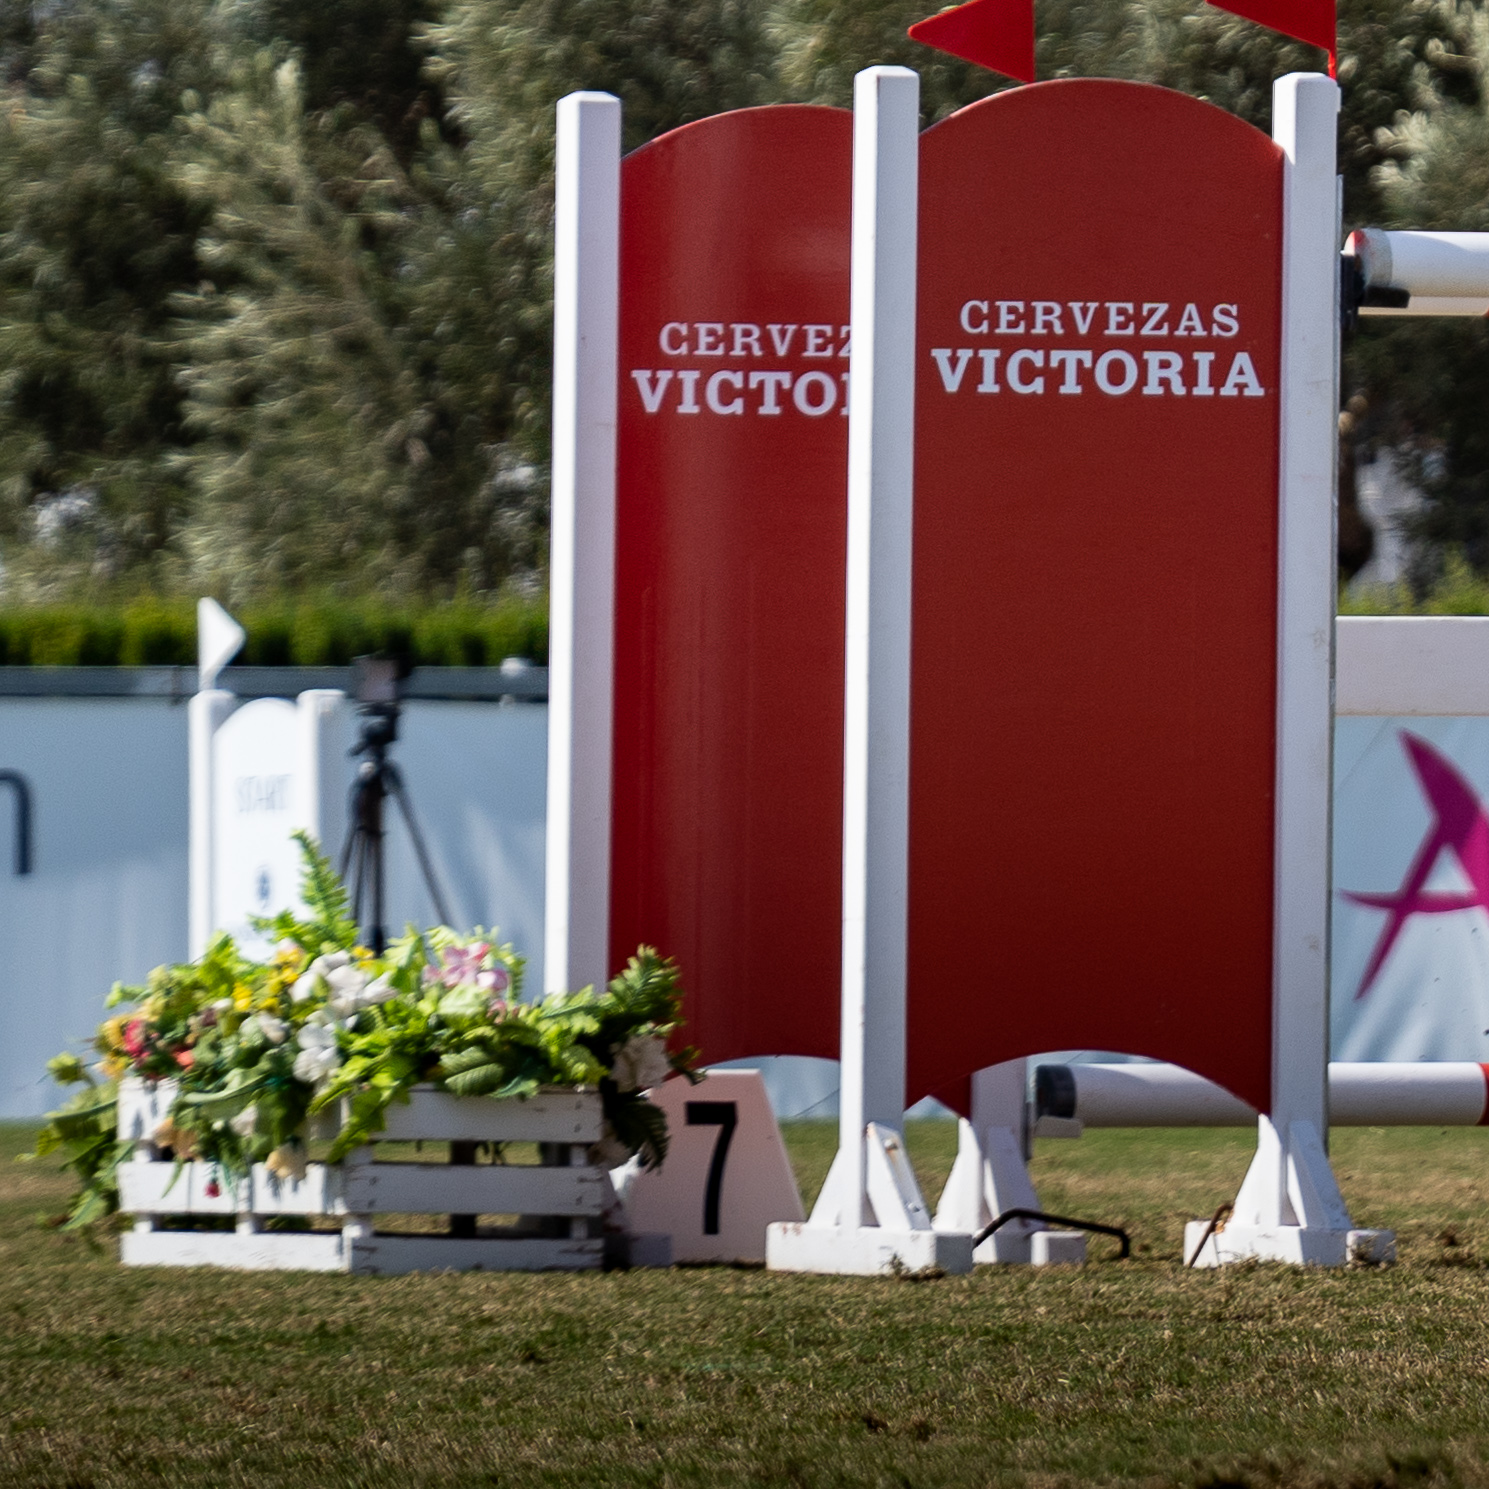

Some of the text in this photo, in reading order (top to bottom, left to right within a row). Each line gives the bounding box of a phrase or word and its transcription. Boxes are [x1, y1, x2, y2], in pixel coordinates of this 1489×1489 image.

[959, 299, 1241, 338] CERVEZAS
[632, 369, 850, 417] VICTO
[931, 348, 1265, 397] VICTORIA
[684, 1100, 738, 1236] 7
